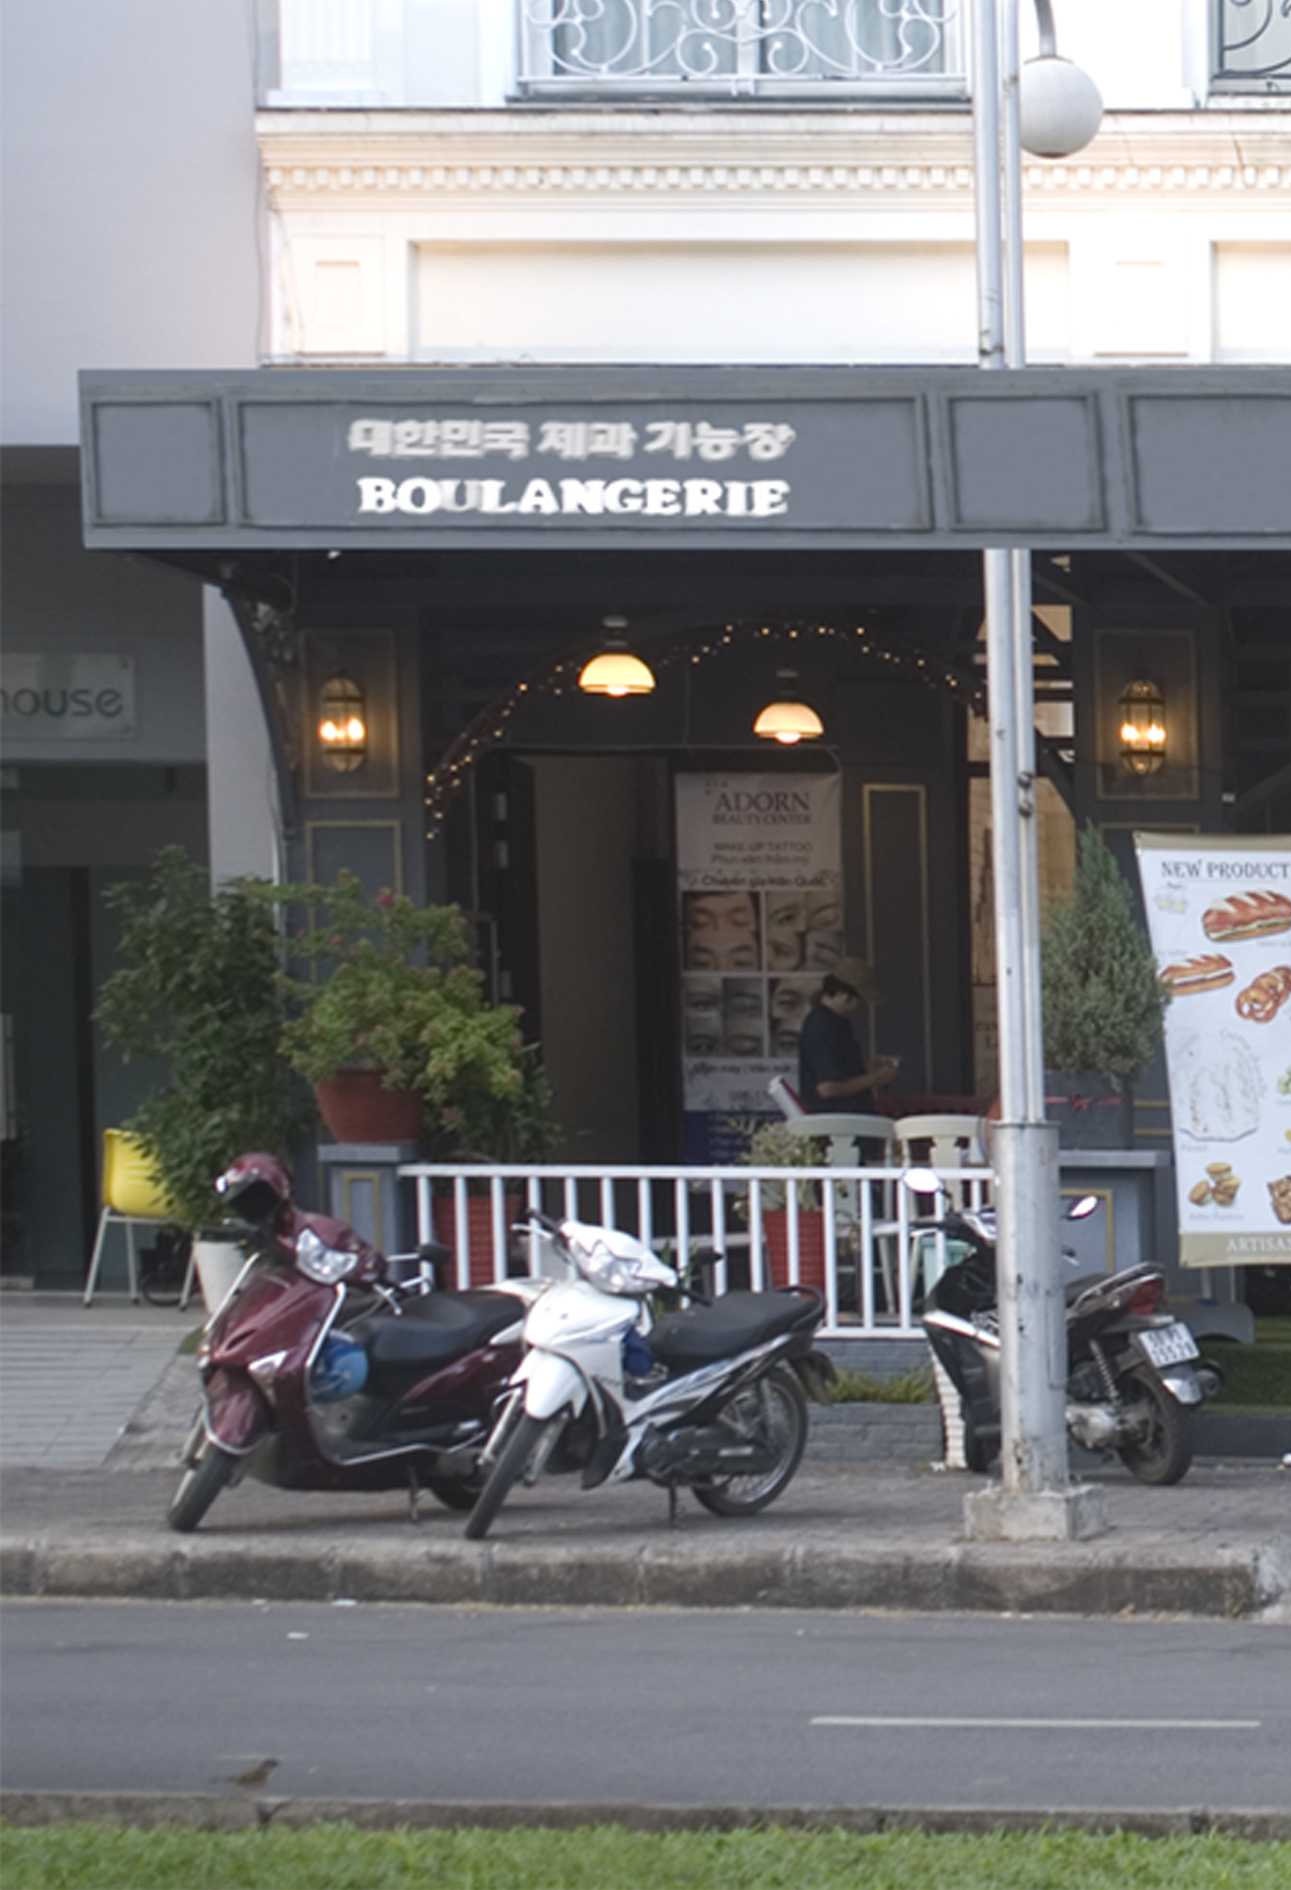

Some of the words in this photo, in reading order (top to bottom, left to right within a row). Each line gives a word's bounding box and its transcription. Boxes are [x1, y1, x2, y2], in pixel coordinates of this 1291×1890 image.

[348, 417, 530, 460] 대한민국
[537, 420, 638, 461] 제과
[643, 420, 796, 462] 기능장
[356, 476, 790, 517] BOULANGERIE
[715, 791, 811, 812] ADORN
[1161, 860, 1203, 878] NEW
[1206, 861, 1291, 879] PRODUCT
